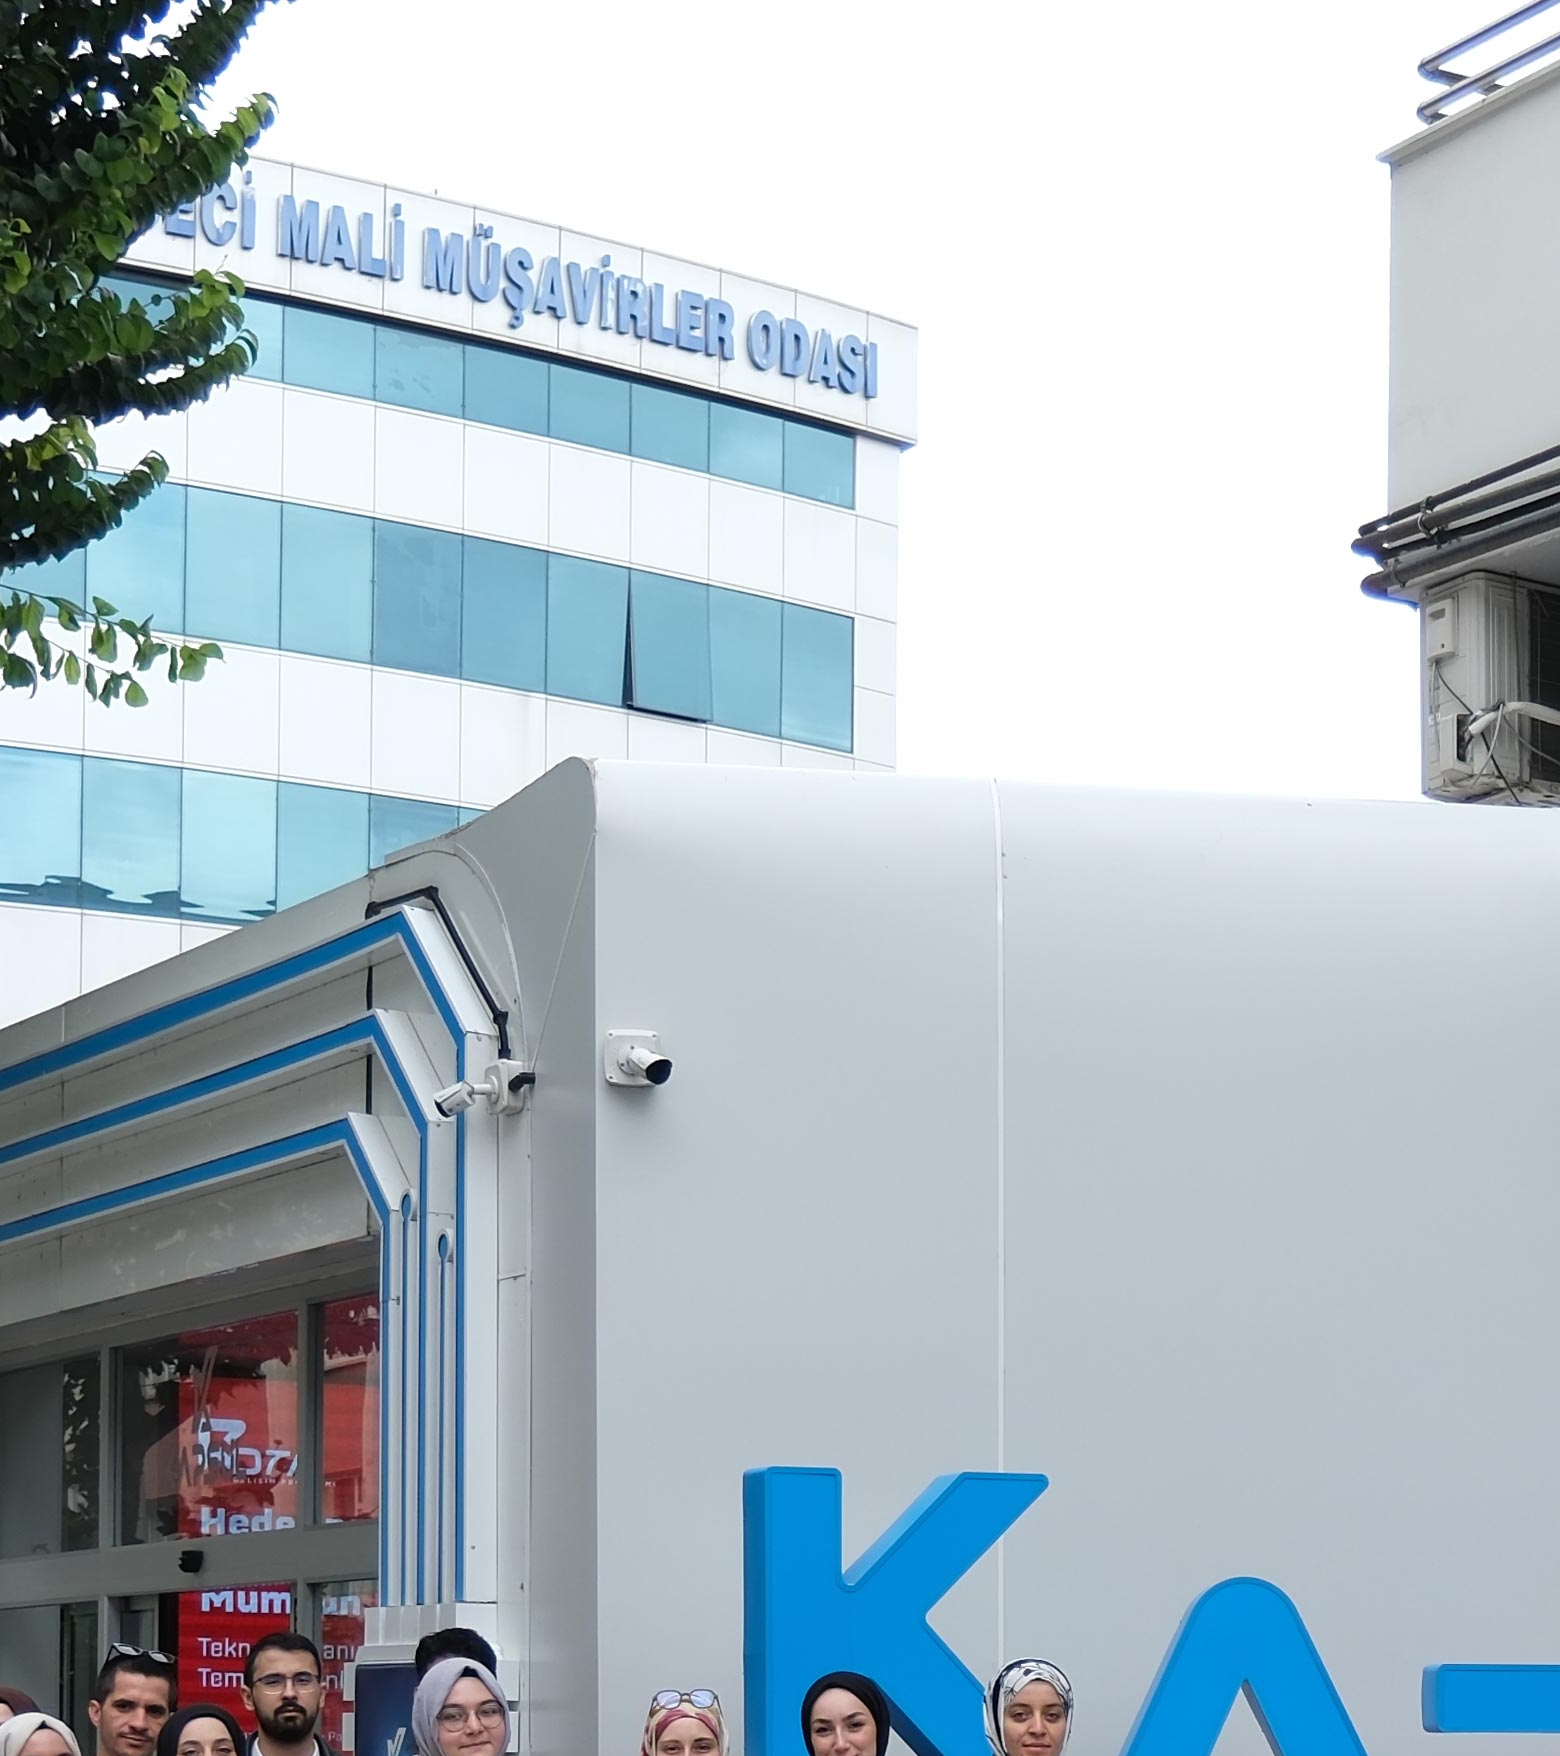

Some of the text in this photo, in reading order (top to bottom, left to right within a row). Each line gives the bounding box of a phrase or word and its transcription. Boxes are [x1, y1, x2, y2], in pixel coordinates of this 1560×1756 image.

[277, 194, 405, 281] MALİ
[423, 222, 735, 361] MÜŞAVİRLER
[747, 309, 878, 398] ODASI
